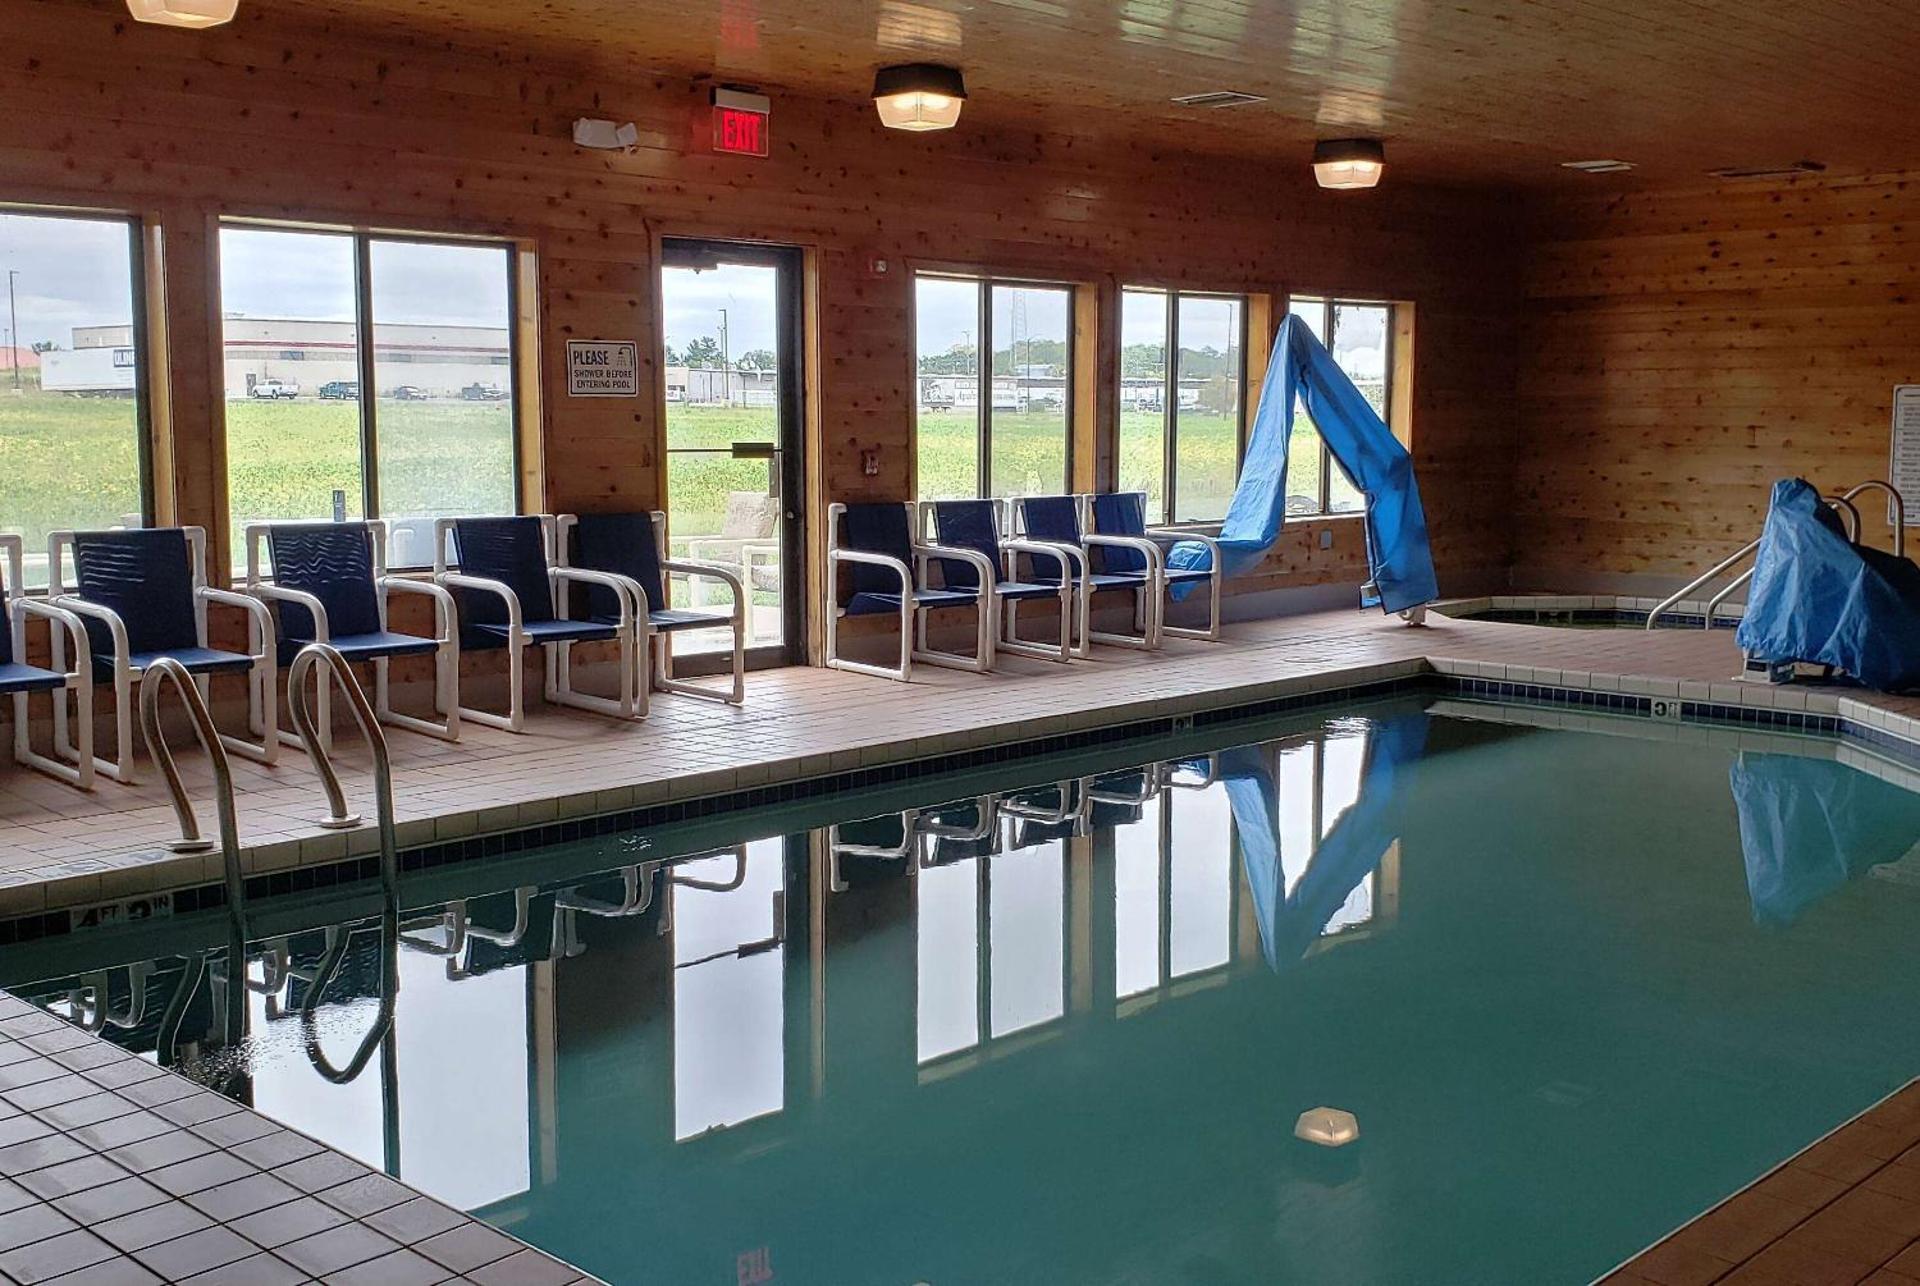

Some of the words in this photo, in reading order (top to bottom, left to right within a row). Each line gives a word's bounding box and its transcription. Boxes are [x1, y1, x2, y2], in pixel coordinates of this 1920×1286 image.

[723, 110, 760, 152] EXIT
[573, 350, 609, 365] PLEASE
[574, 369, 603, 378] SHOWER
[606, 370, 632, 378] BEFORE
[577, 380, 610, 389] ENTERING
[612, 380, 631, 389] POOL
